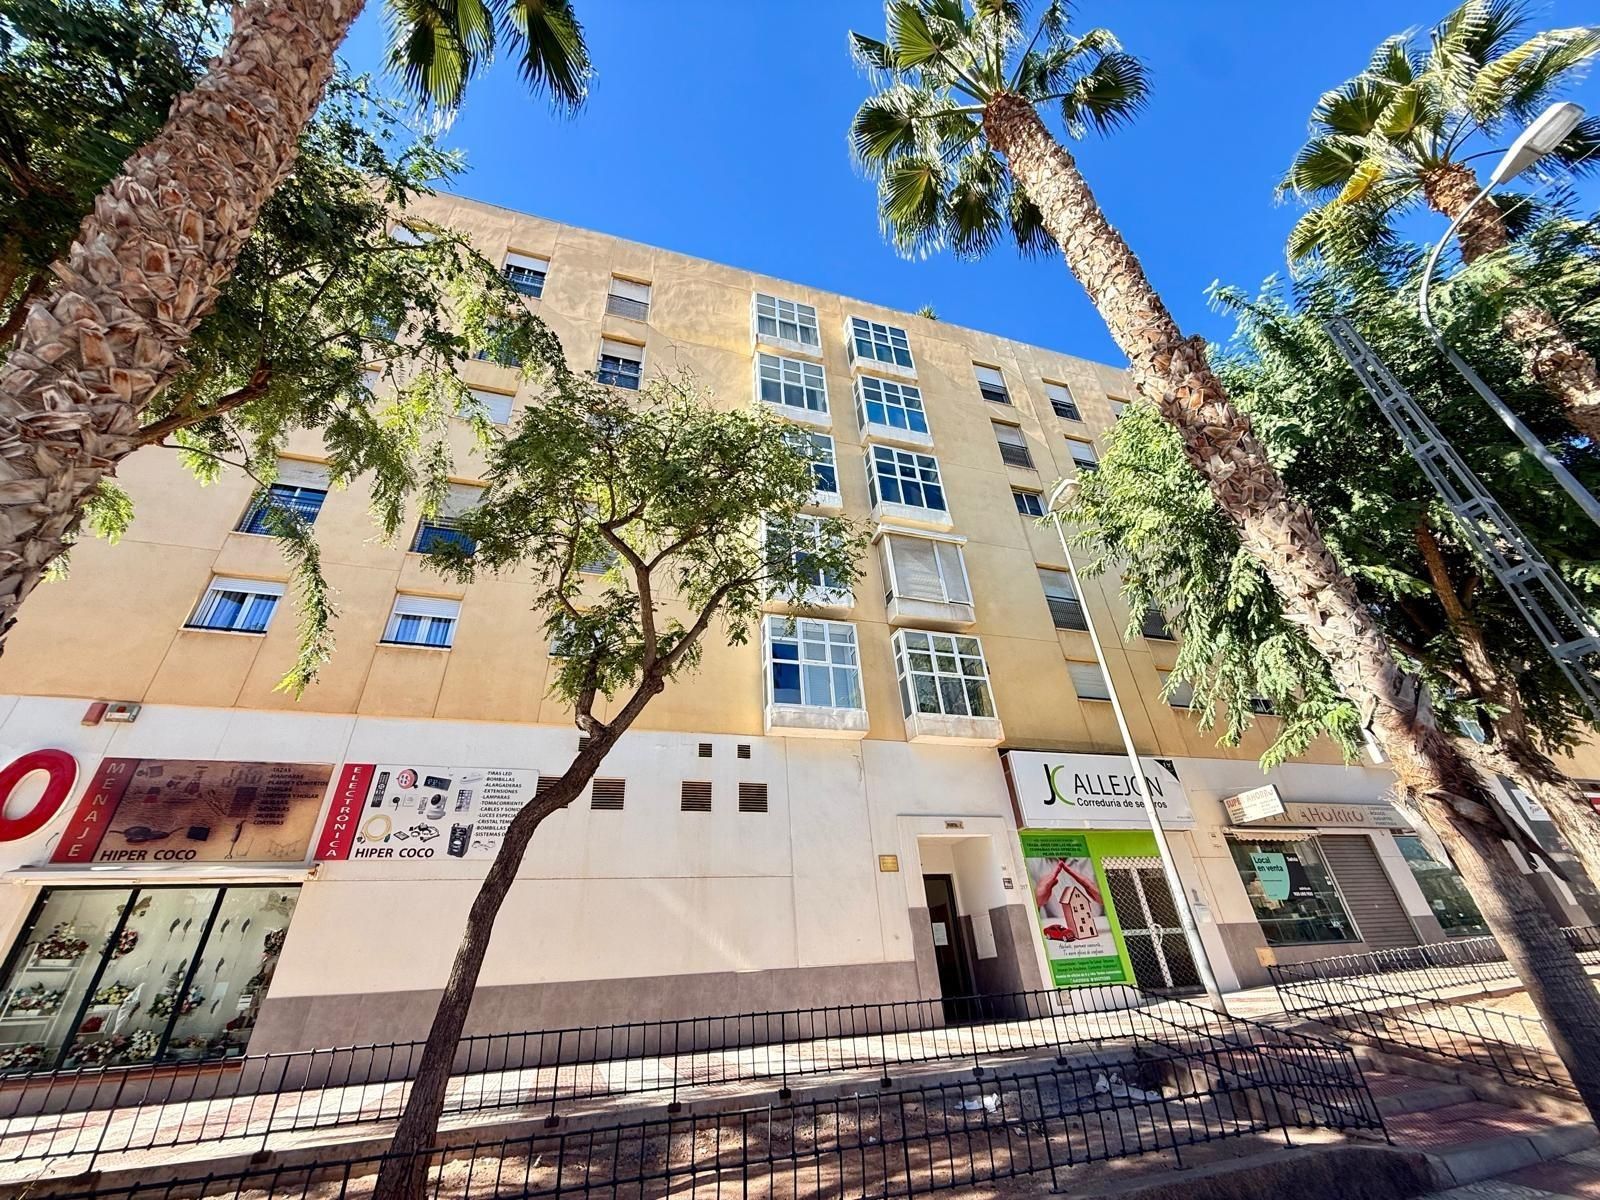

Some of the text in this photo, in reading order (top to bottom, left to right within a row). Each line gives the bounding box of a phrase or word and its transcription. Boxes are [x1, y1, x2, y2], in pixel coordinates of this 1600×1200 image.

[0, 749, 78, 841] O
[68, 763, 125, 857] MENAJE
[1123, 799, 1134, 808] de
[1135, 800, 1168, 809] seros
[326, 766, 363, 857] ELECTRÓNICA
[100, 849, 197, 861] HIPER COCO
[355, 848, 435, 858] HIPER COCO
[1253, 856, 1271, 864] Local
